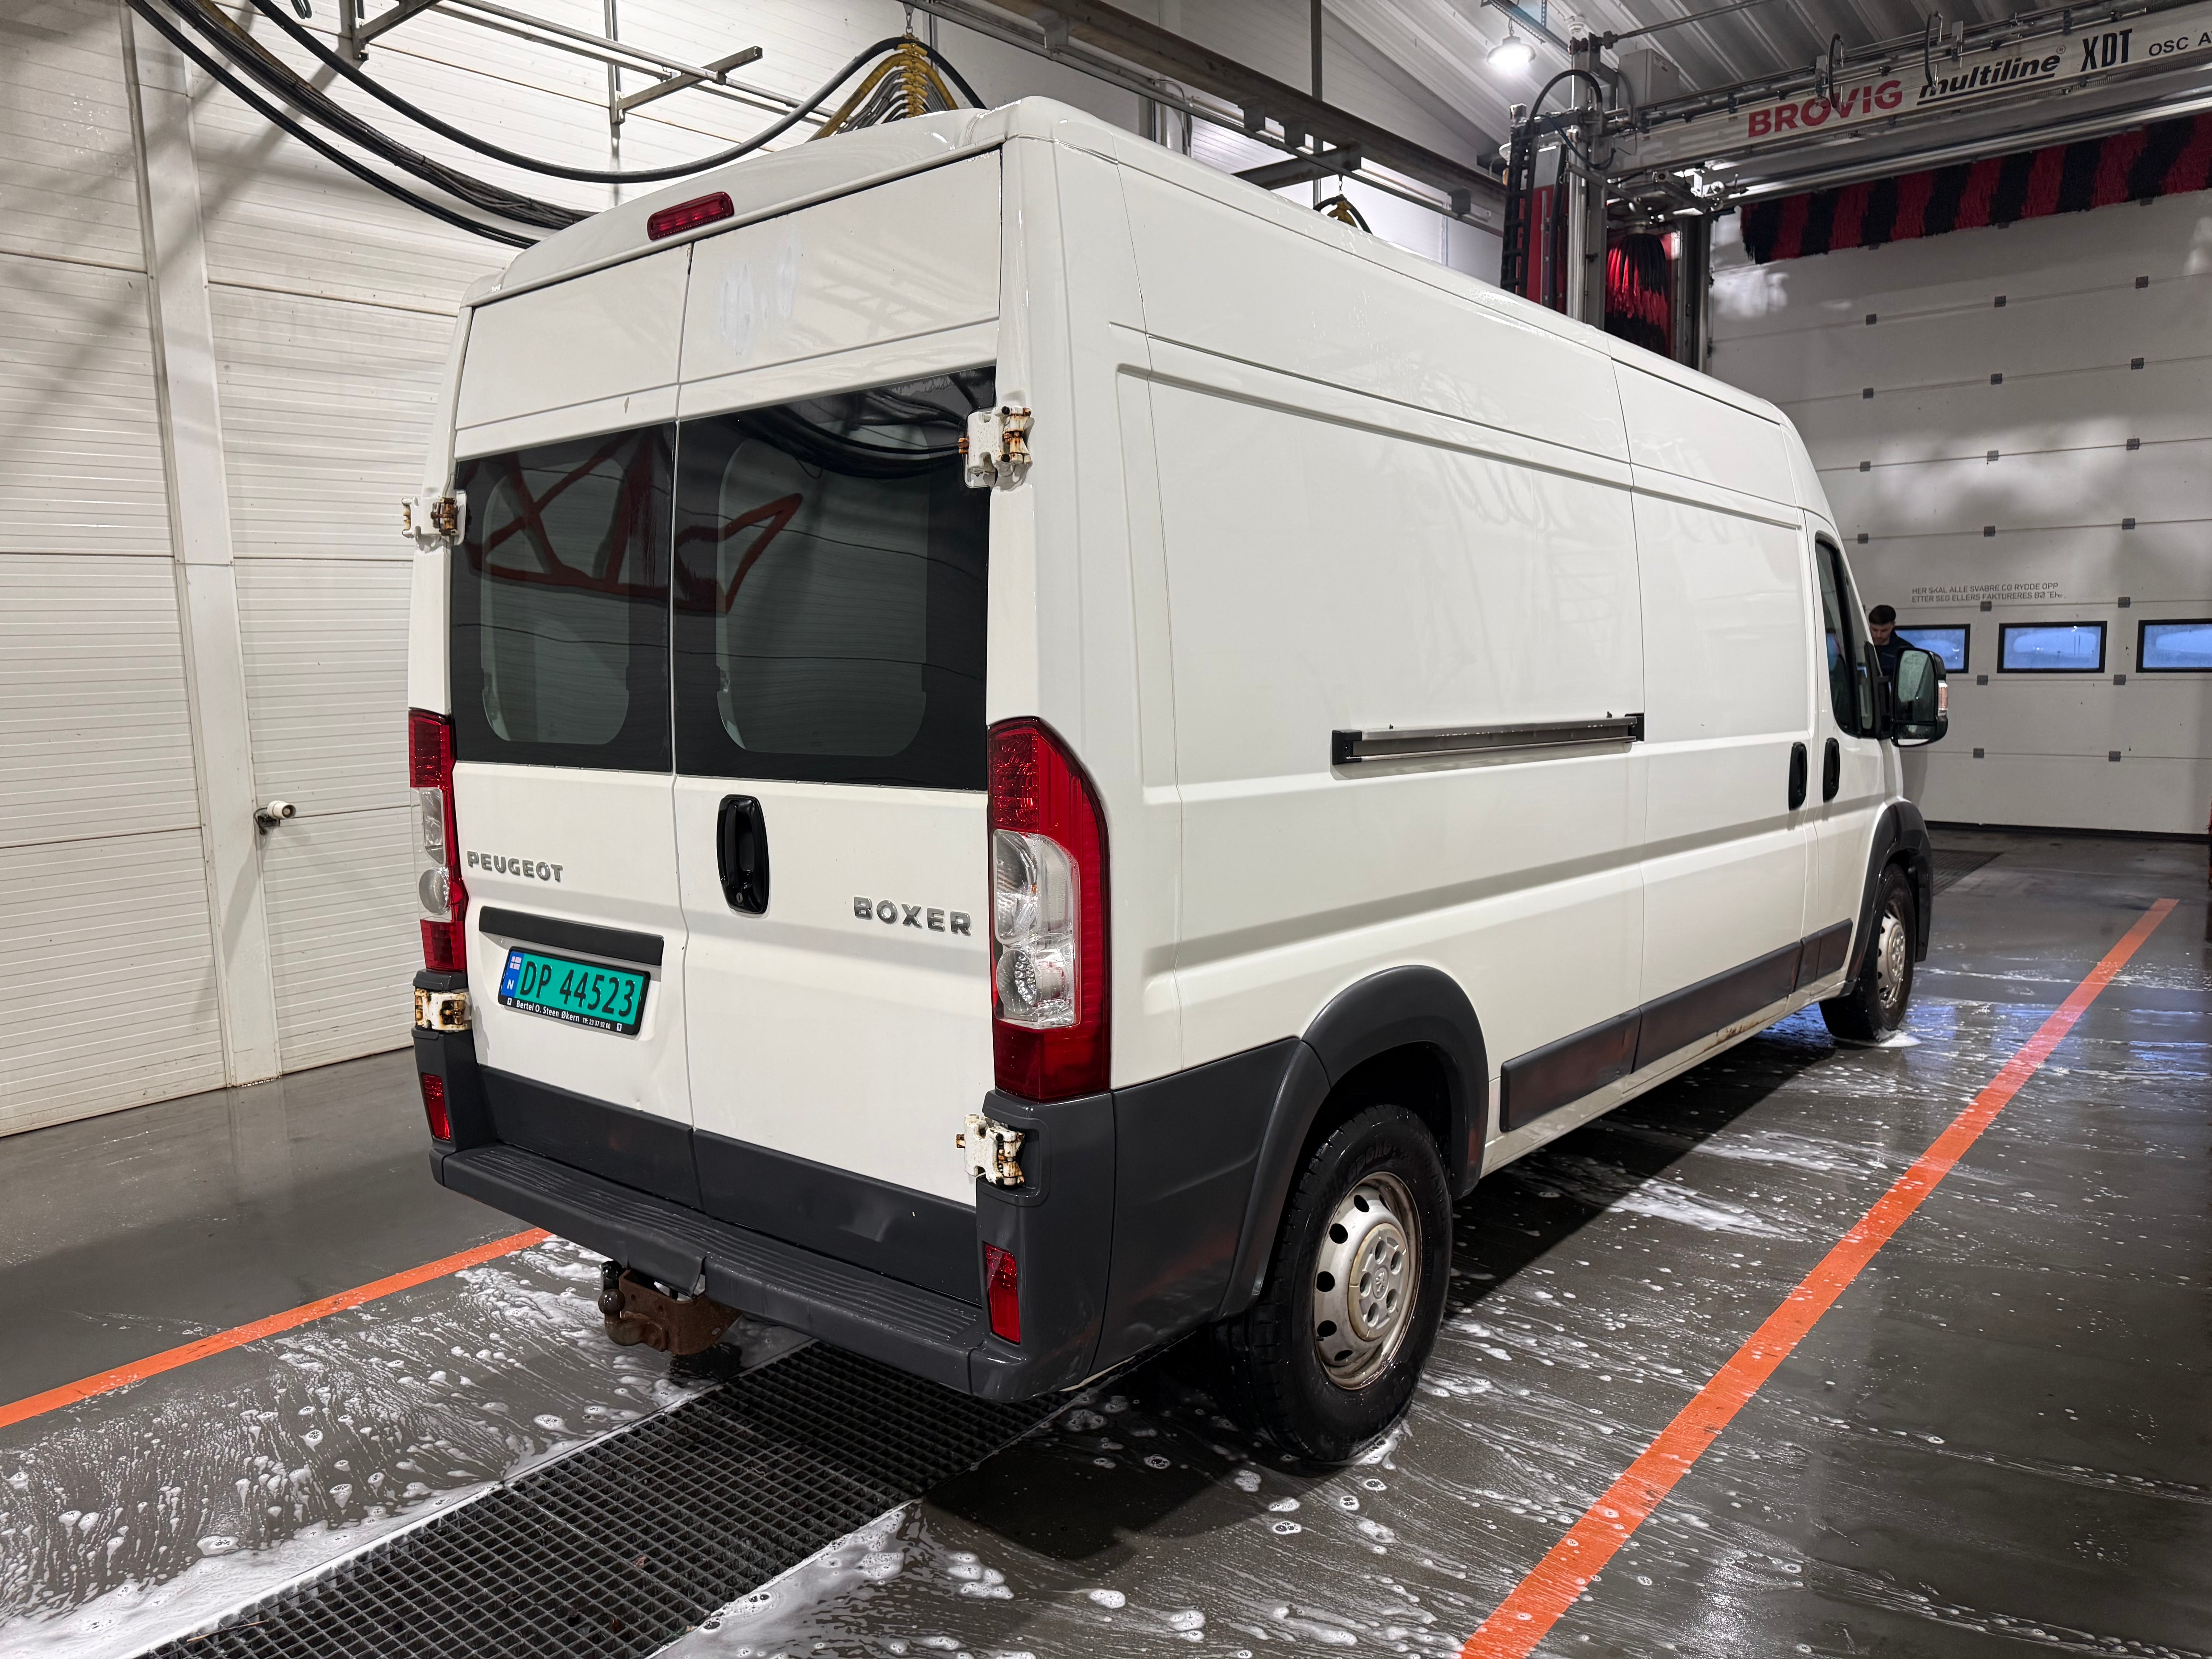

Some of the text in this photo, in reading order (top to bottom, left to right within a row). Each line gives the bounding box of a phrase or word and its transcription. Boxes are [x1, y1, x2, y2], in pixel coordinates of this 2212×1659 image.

[1748, 28, 2212, 137] BROVIG multiline XDT OSC A
[1952, 593, 1980, 601] ELLERS
[1982, 591, 2032, 600] FAKTURERES
[1970, 584, 1999, 592] SVABRE
[467, 851, 563, 882] PEUGEOT
[854, 896, 971, 936] BOXER
[507, 980, 514, 990] N
[520, 961, 635, 1017] DP 44523
[516, 1000, 534, 1011] Bertel
[535, 1005, 541, 1013] O.
[543, 1006, 559, 1017] Steen
[561, 1011, 580, 1022] Økern
